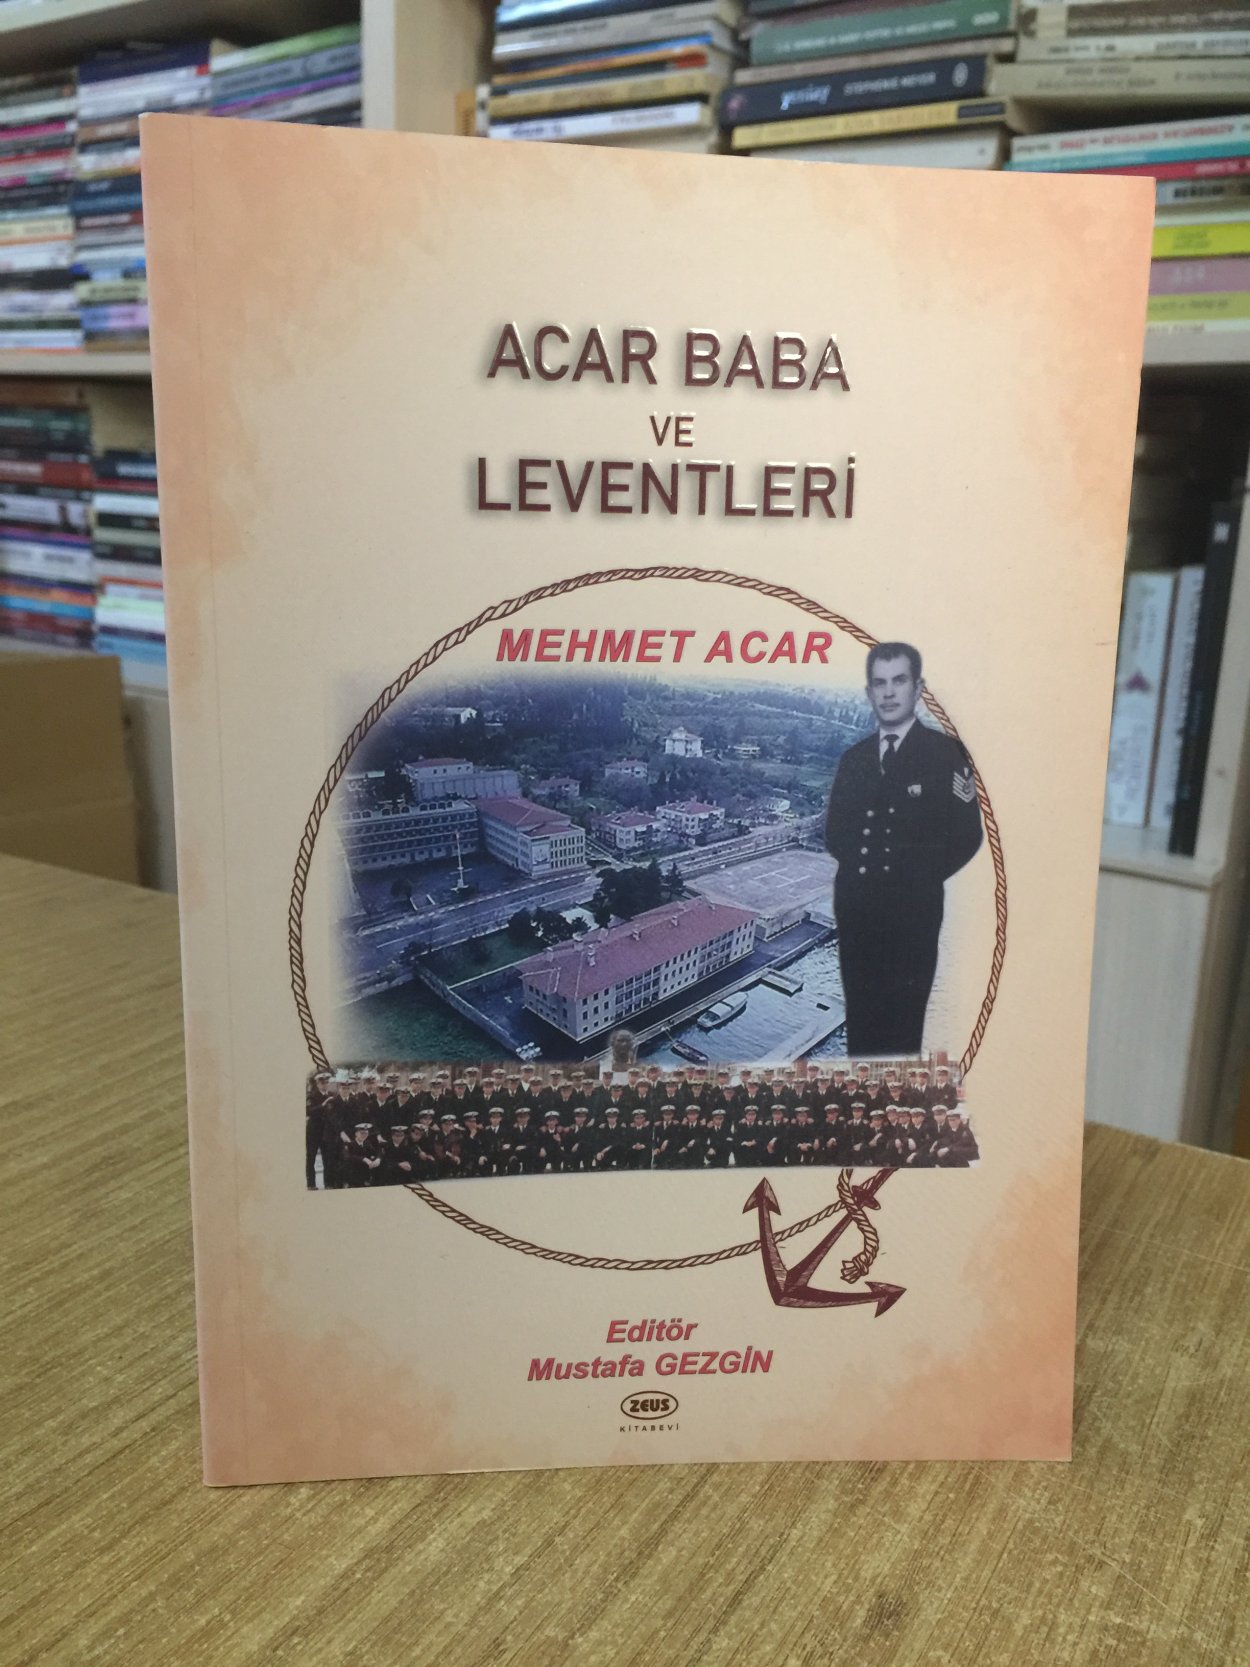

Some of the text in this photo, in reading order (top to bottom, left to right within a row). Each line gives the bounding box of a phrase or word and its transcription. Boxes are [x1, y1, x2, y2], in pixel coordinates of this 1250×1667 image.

[486, 321, 851, 391] ACAR BABA
[649, 411, 696, 447] VE
[477, 452, 857, 518] LEVENTLERİ
[496, 628, 834, 665] MEHMET ACAR
[606, 1317, 699, 1344] Editör
[527, 1345, 774, 1382] Mustafa GEZGİN
[629, 1398, 671, 1413] ZEUS
[619, 1422, 680, 1433] KİTABEVİ
